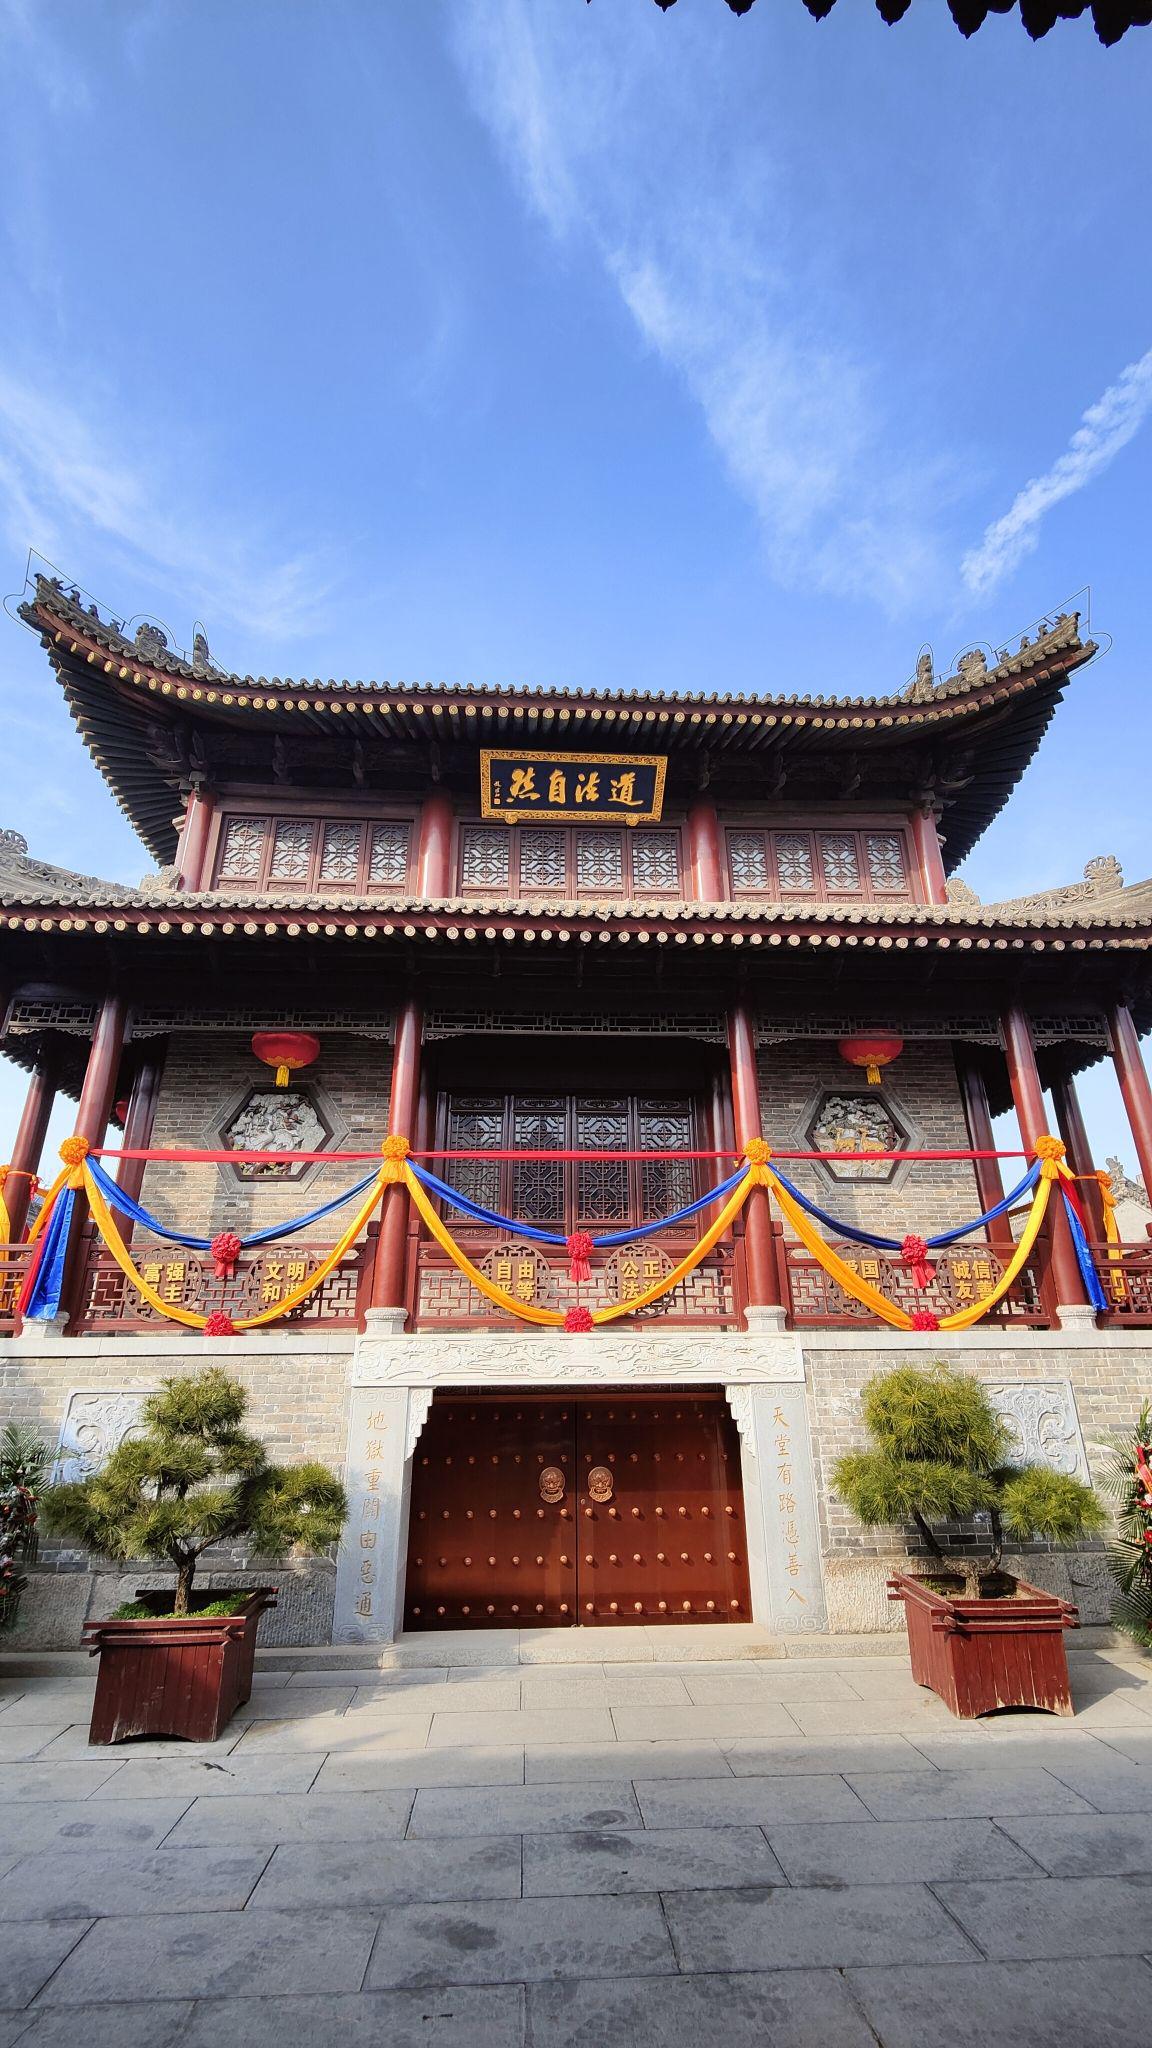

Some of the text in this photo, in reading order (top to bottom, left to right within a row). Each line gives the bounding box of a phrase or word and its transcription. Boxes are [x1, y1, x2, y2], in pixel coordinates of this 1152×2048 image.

[144, 1262, 185, 1282] 富强
[265, 1261, 306, 1281] 文明
[497, 1260, 535, 1279] 自由
[621, 1260, 660, 1278] 公正
[952, 1261, 991, 1279] 诚信
[496, 1282, 535, 1301] 平等
[955, 1281, 995, 1300] 友善
